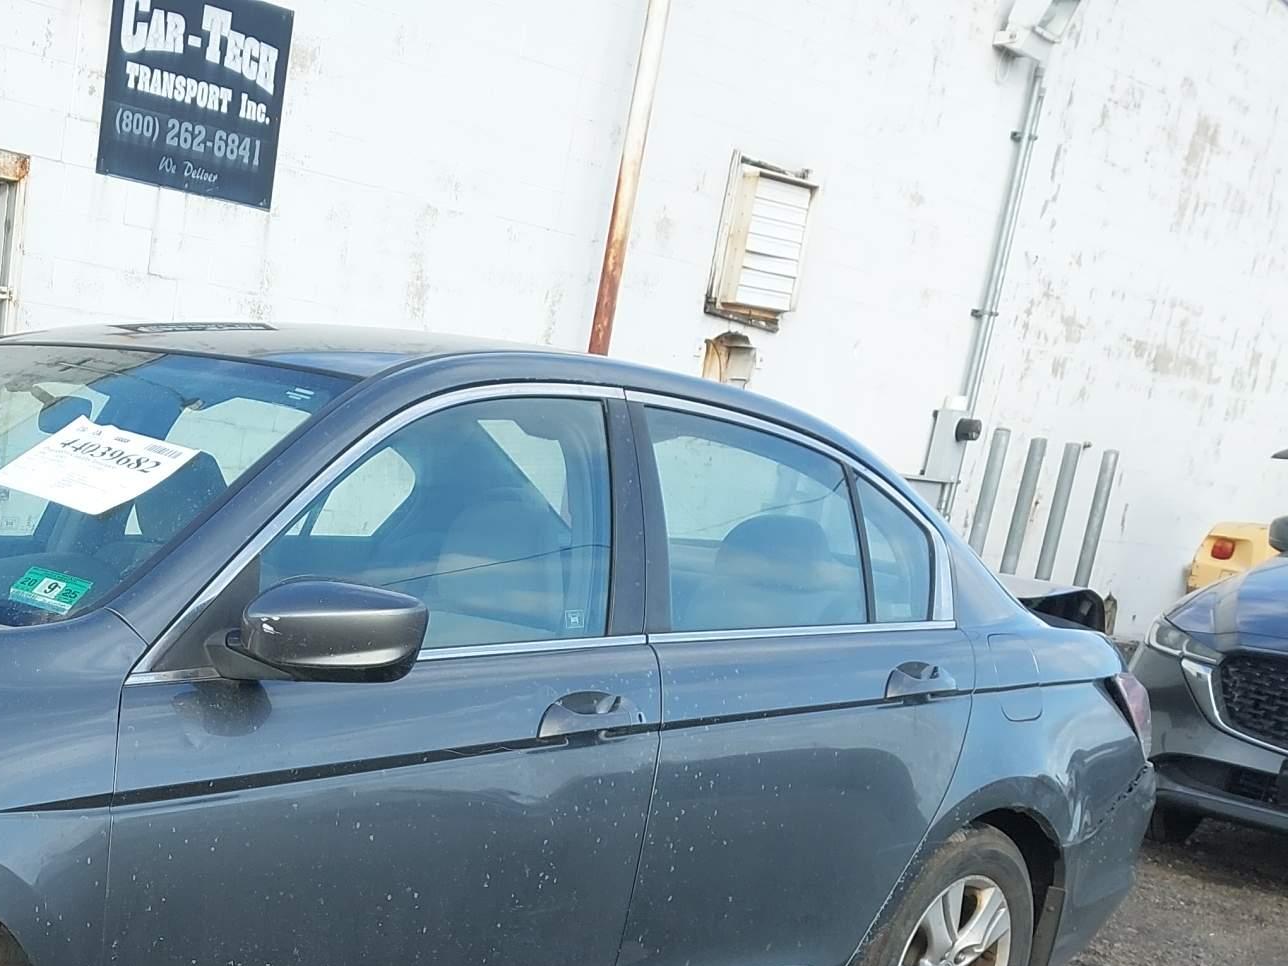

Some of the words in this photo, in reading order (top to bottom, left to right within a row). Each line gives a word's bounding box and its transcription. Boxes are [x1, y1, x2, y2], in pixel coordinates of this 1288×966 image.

[125, 61, 233, 114] TRANSPORT
[239, 93, 271, 125] Inc.
[115, 108, 160, 142] (800)
[166, 118, 262, 167] 262-6841
[158, 155, 177, 174] We
[60, 438, 161, 474] 44039682
[20, 577, 38, 587] 20
[44, 582, 61, 594] 9
[62, 588, 80, 599] 25
